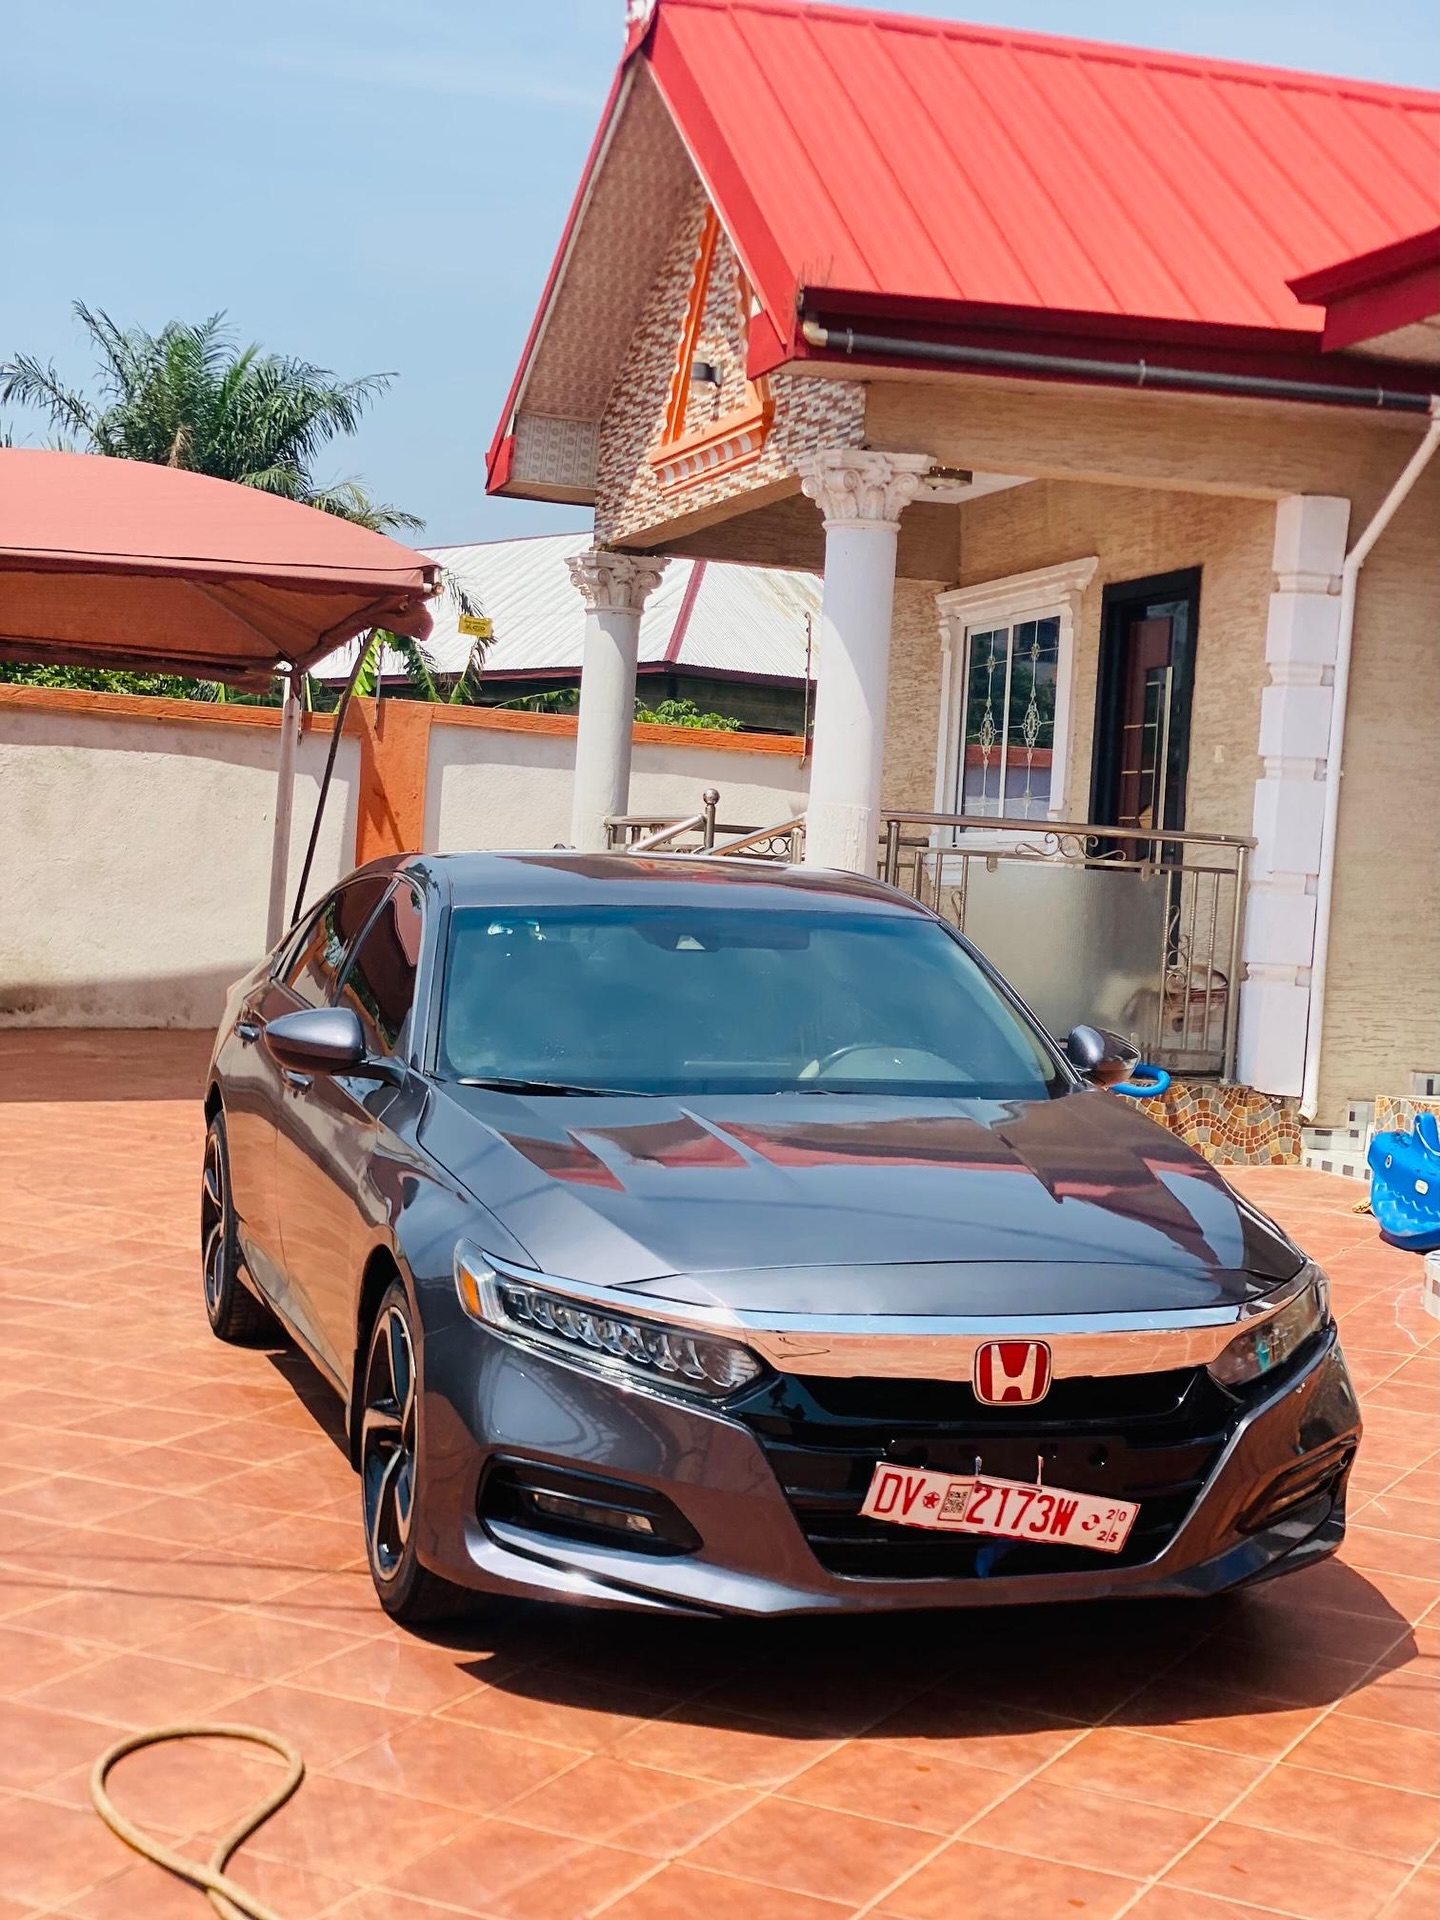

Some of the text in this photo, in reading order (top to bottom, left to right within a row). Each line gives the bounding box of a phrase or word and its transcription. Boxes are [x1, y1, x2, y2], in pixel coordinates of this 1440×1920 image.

[873, 1473, 1079, 1536] DV 2173W
[1106, 1509, 1127, 1522] 20
[1096, 1530, 1118, 1543] 25
